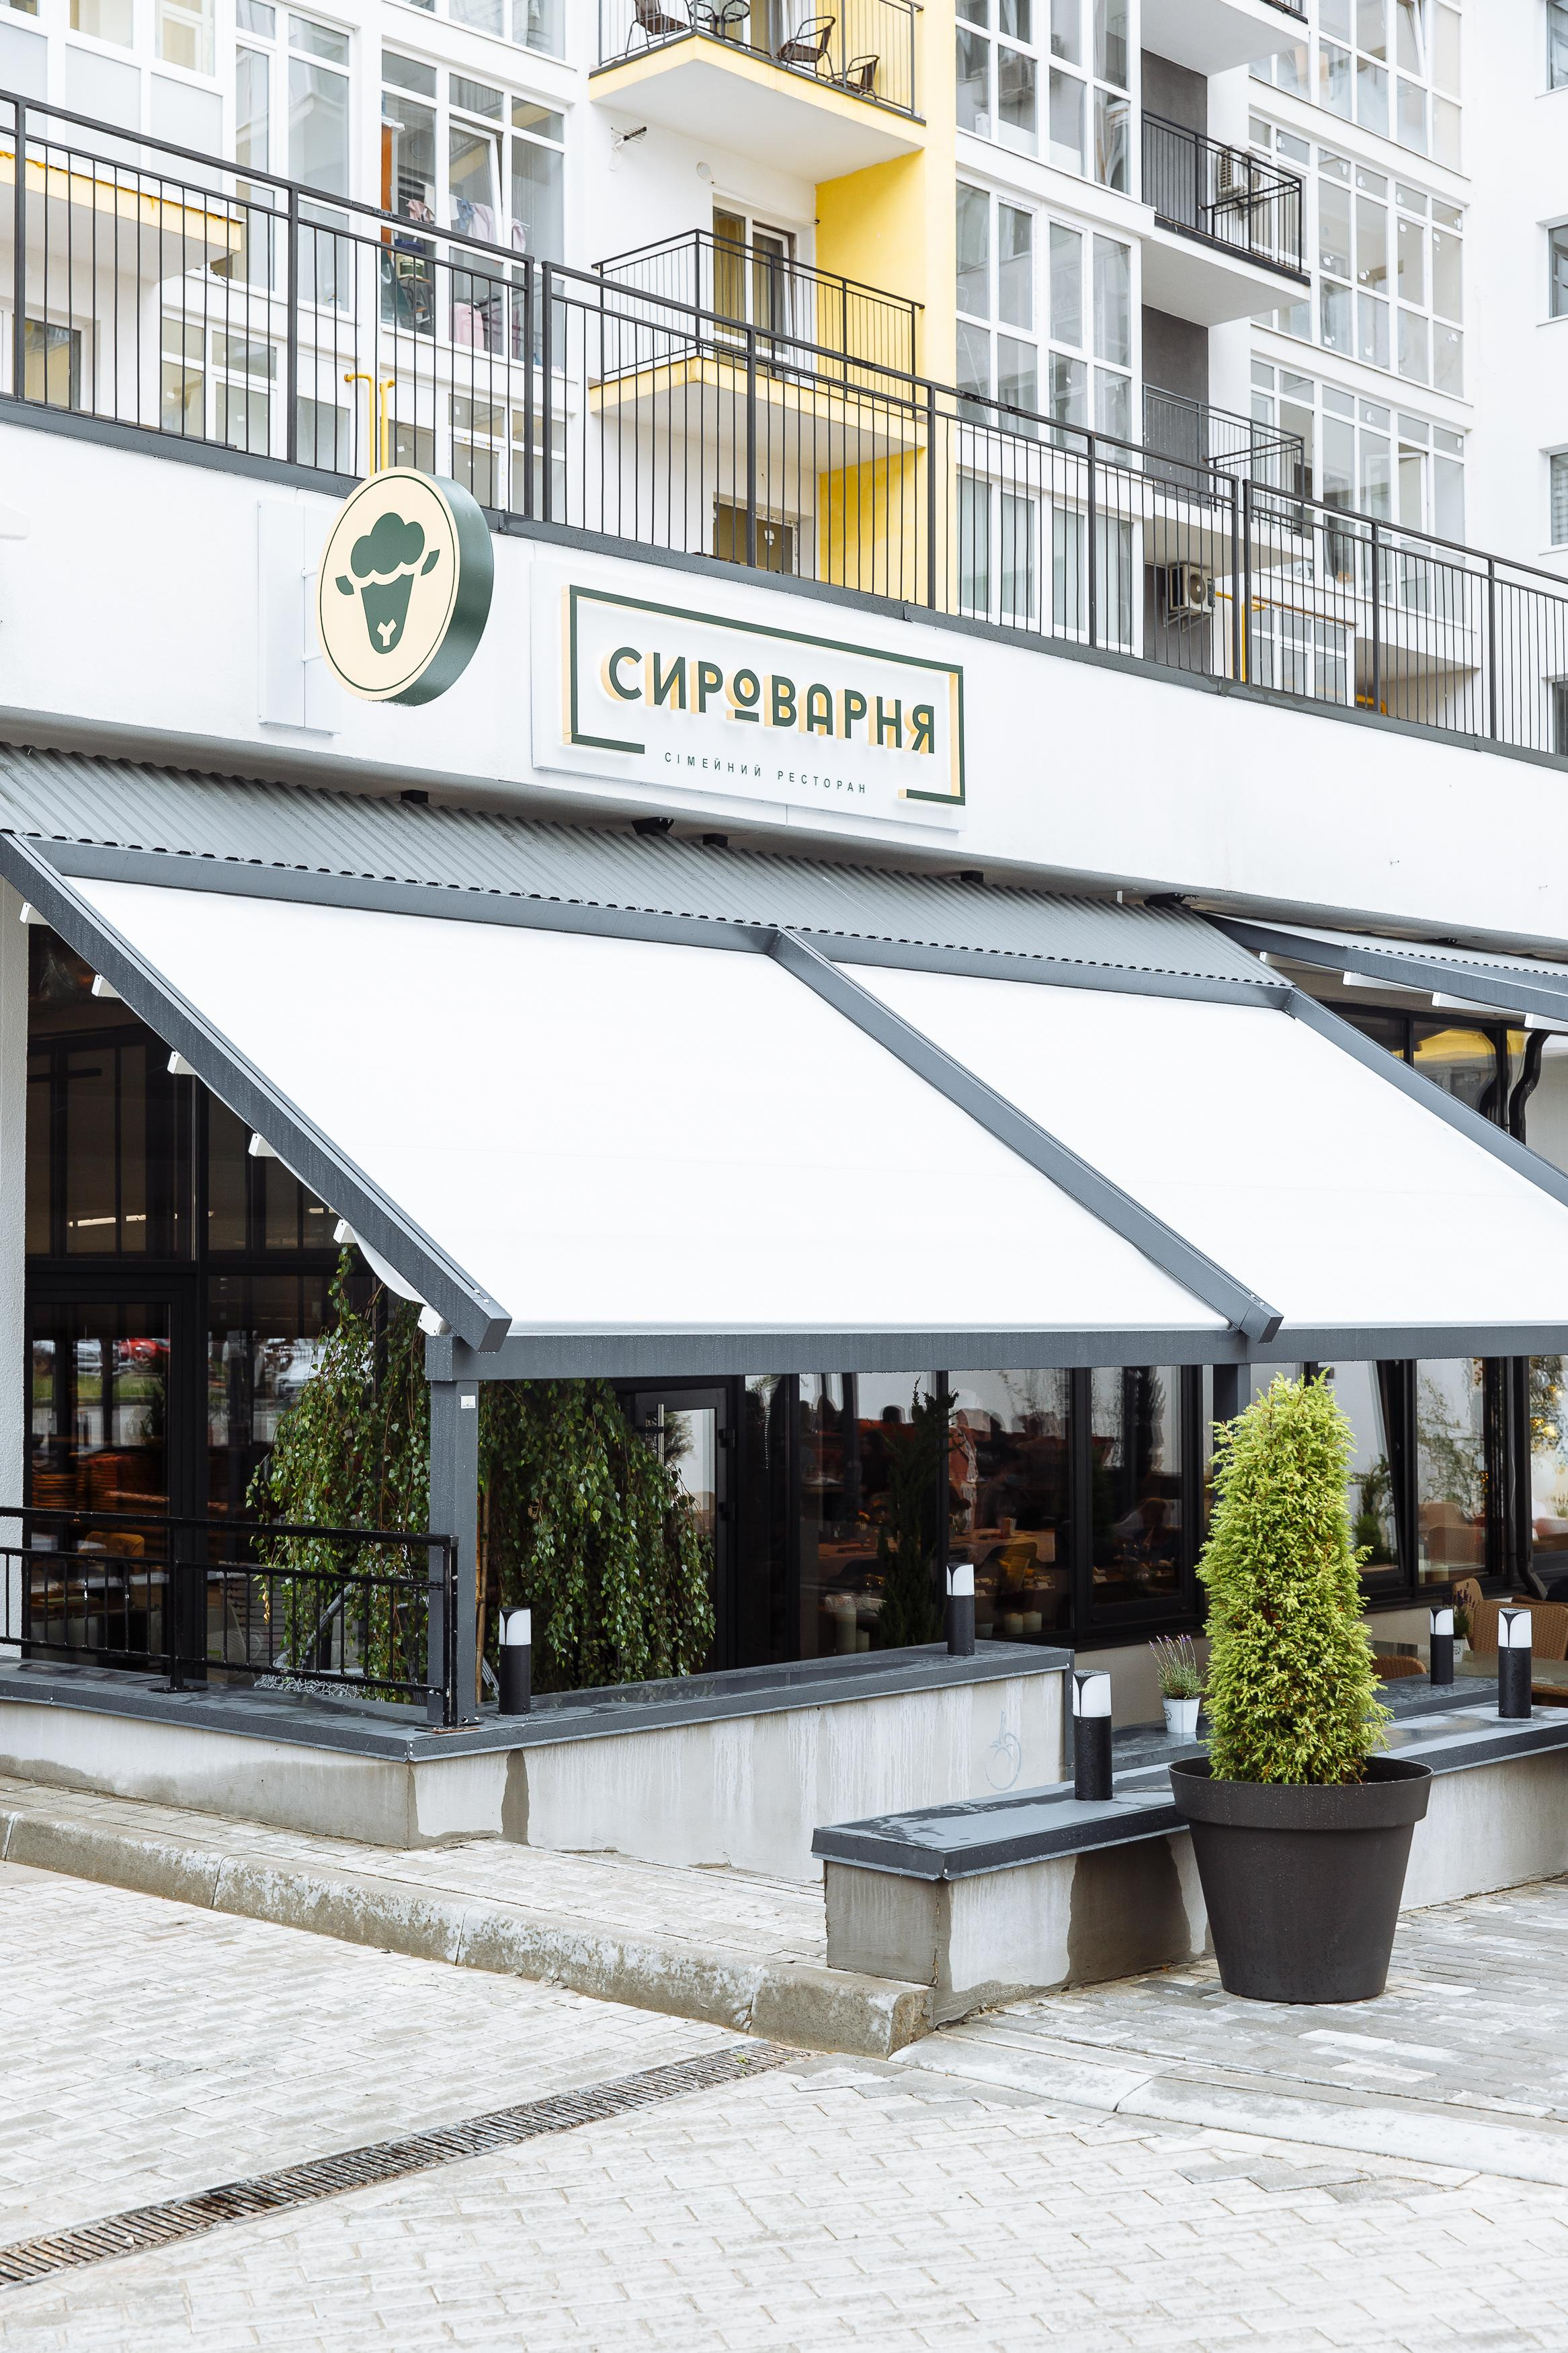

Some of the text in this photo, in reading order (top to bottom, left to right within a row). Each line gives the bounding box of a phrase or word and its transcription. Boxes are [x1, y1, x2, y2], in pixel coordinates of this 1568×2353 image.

[604, 646, 935, 754] СИРОВАРНЯ
[665, 752, 866, 794] СІМЕЙНИЙ РЕСТОРАН
